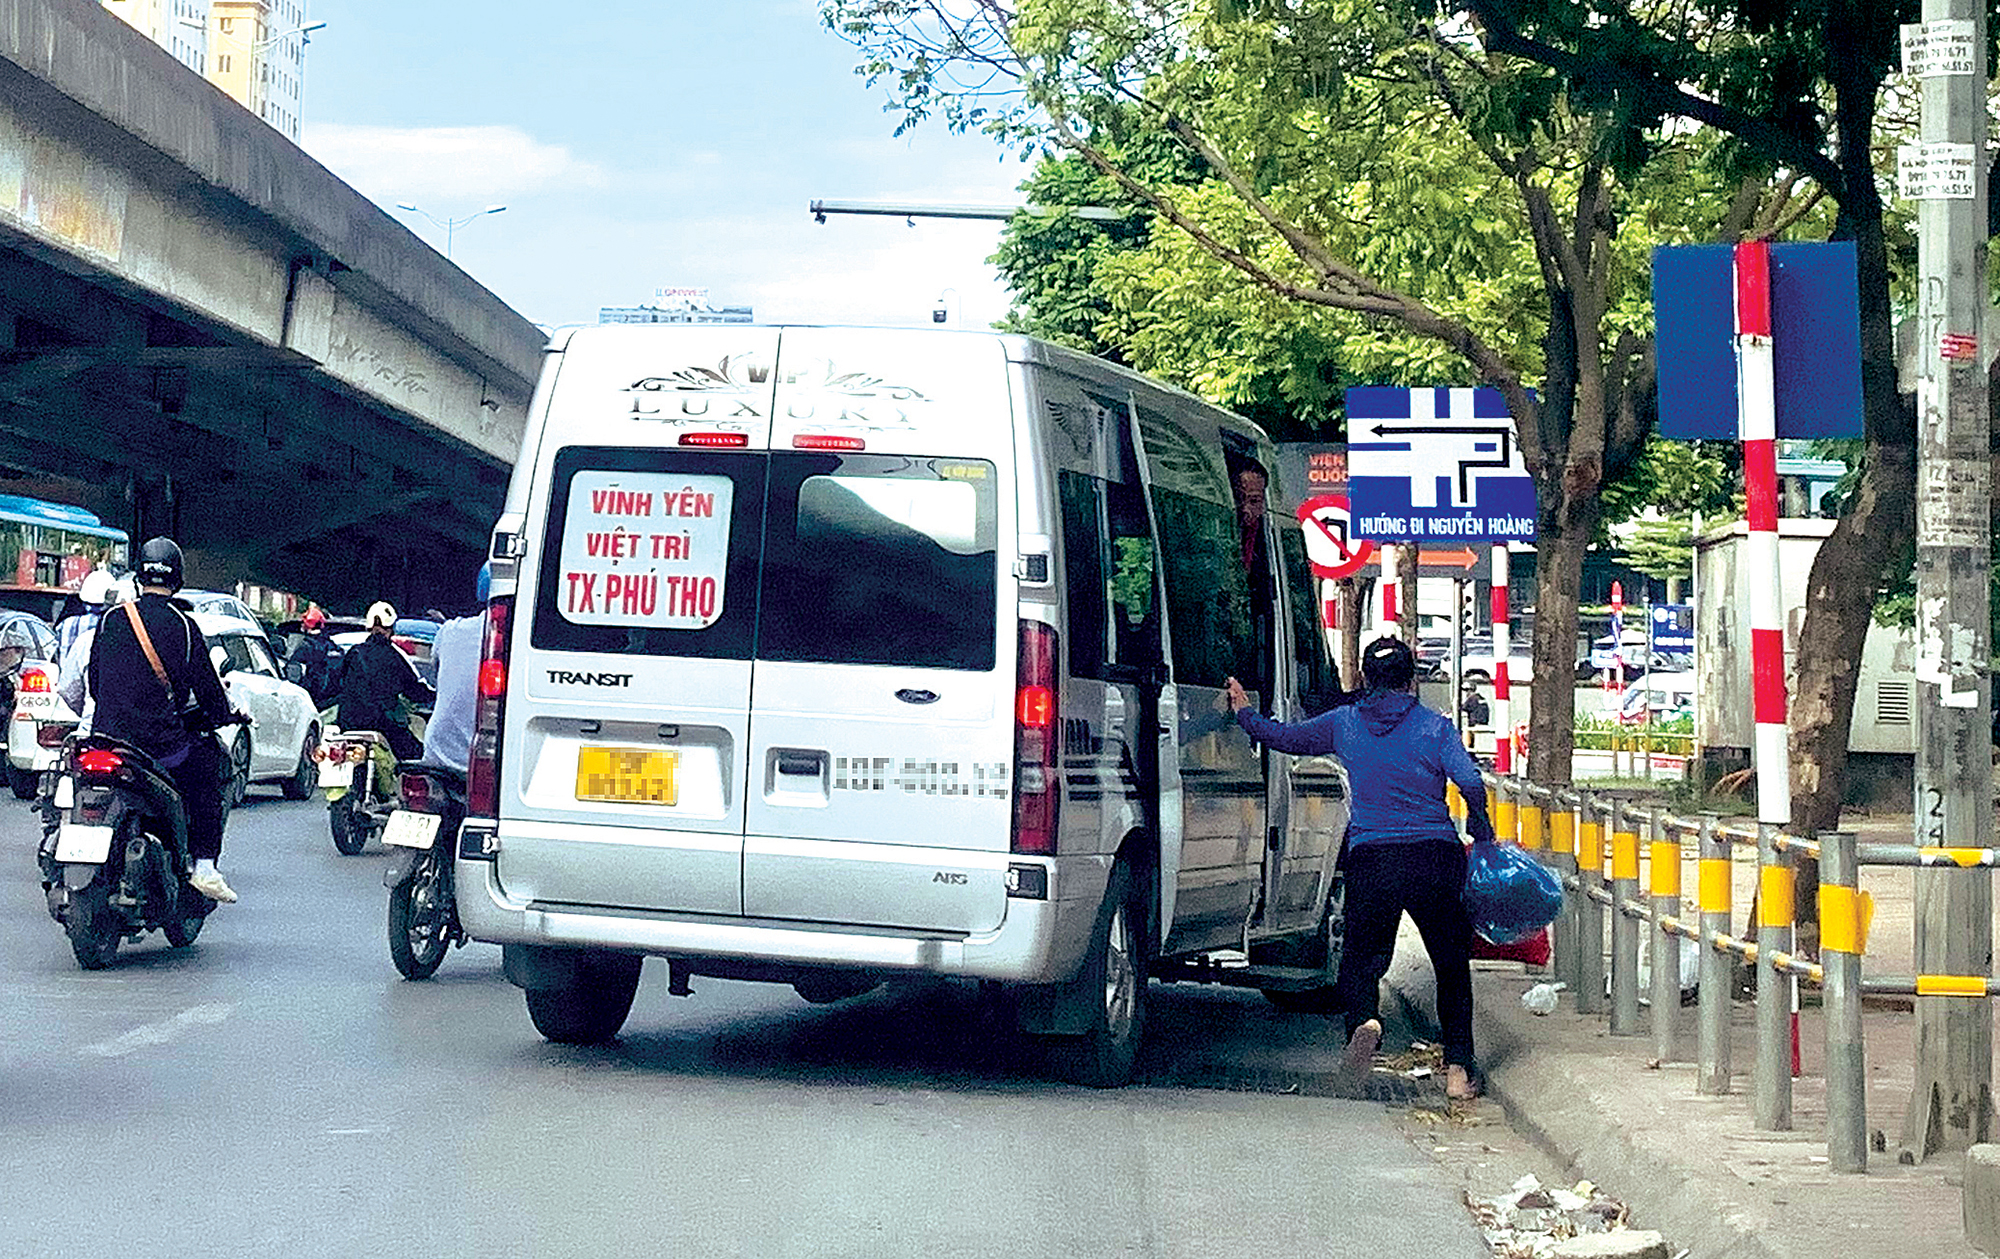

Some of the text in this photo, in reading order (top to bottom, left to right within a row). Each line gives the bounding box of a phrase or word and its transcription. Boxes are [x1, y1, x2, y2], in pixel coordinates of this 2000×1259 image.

[592, 483, 715, 518] VĨNH YÊN
[1409, 517, 1424, 535] ĐI
[1428, 511, 1483, 535] NGUYỄN
[1488, 512, 1534, 535] HOÀNG
[587, 526, 691, 566] VIỆT TRÌ
[667, 576, 717, 626] THỌ
[546, 670, 633, 687] TRANSIT
[932, 871, 968, 885] ABS
